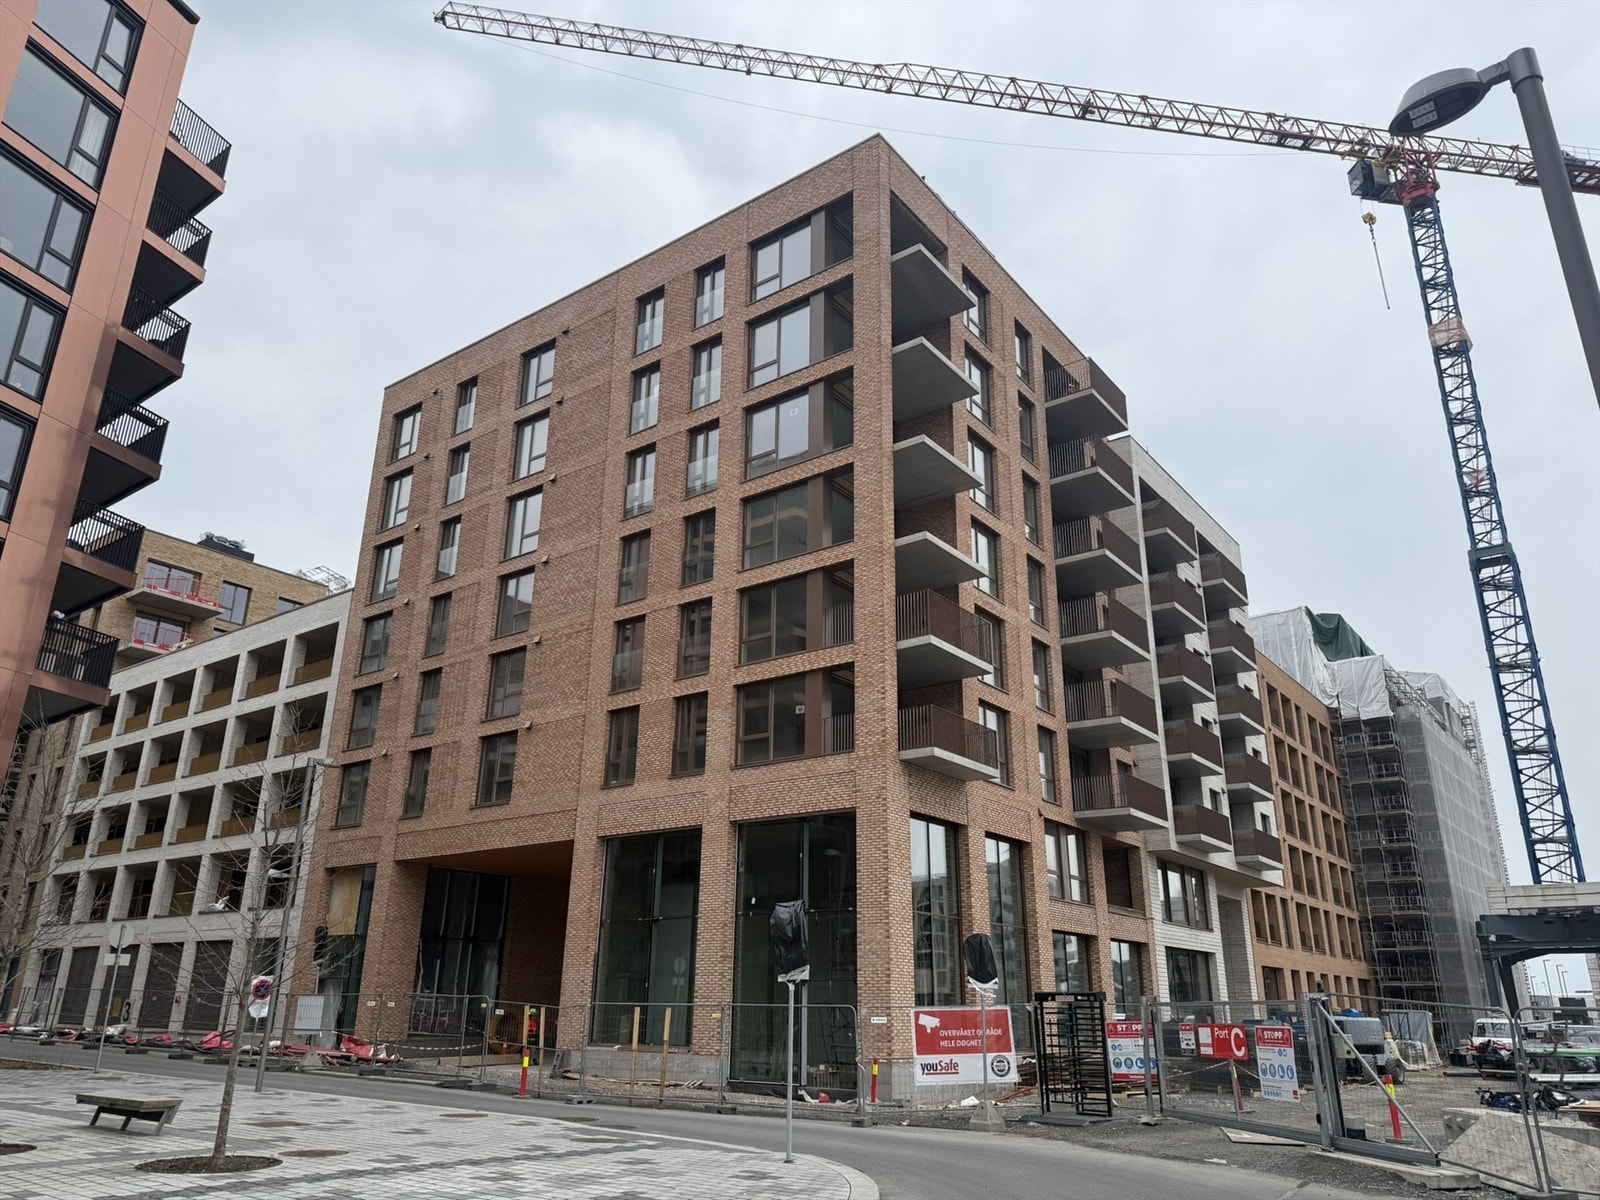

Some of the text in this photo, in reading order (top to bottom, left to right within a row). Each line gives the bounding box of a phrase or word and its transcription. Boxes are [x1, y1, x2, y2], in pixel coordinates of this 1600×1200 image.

[123, 1001, 131, 1022] 3
[939, 1028, 975, 1036] OVERVÅKET
[1263, 1030, 1283, 1039] STOPP
[956, 1039, 982, 1047] DØGNET
[1214, 1027, 1245, 1057] Port C
[920, 1058, 959, 1075] youSafe
